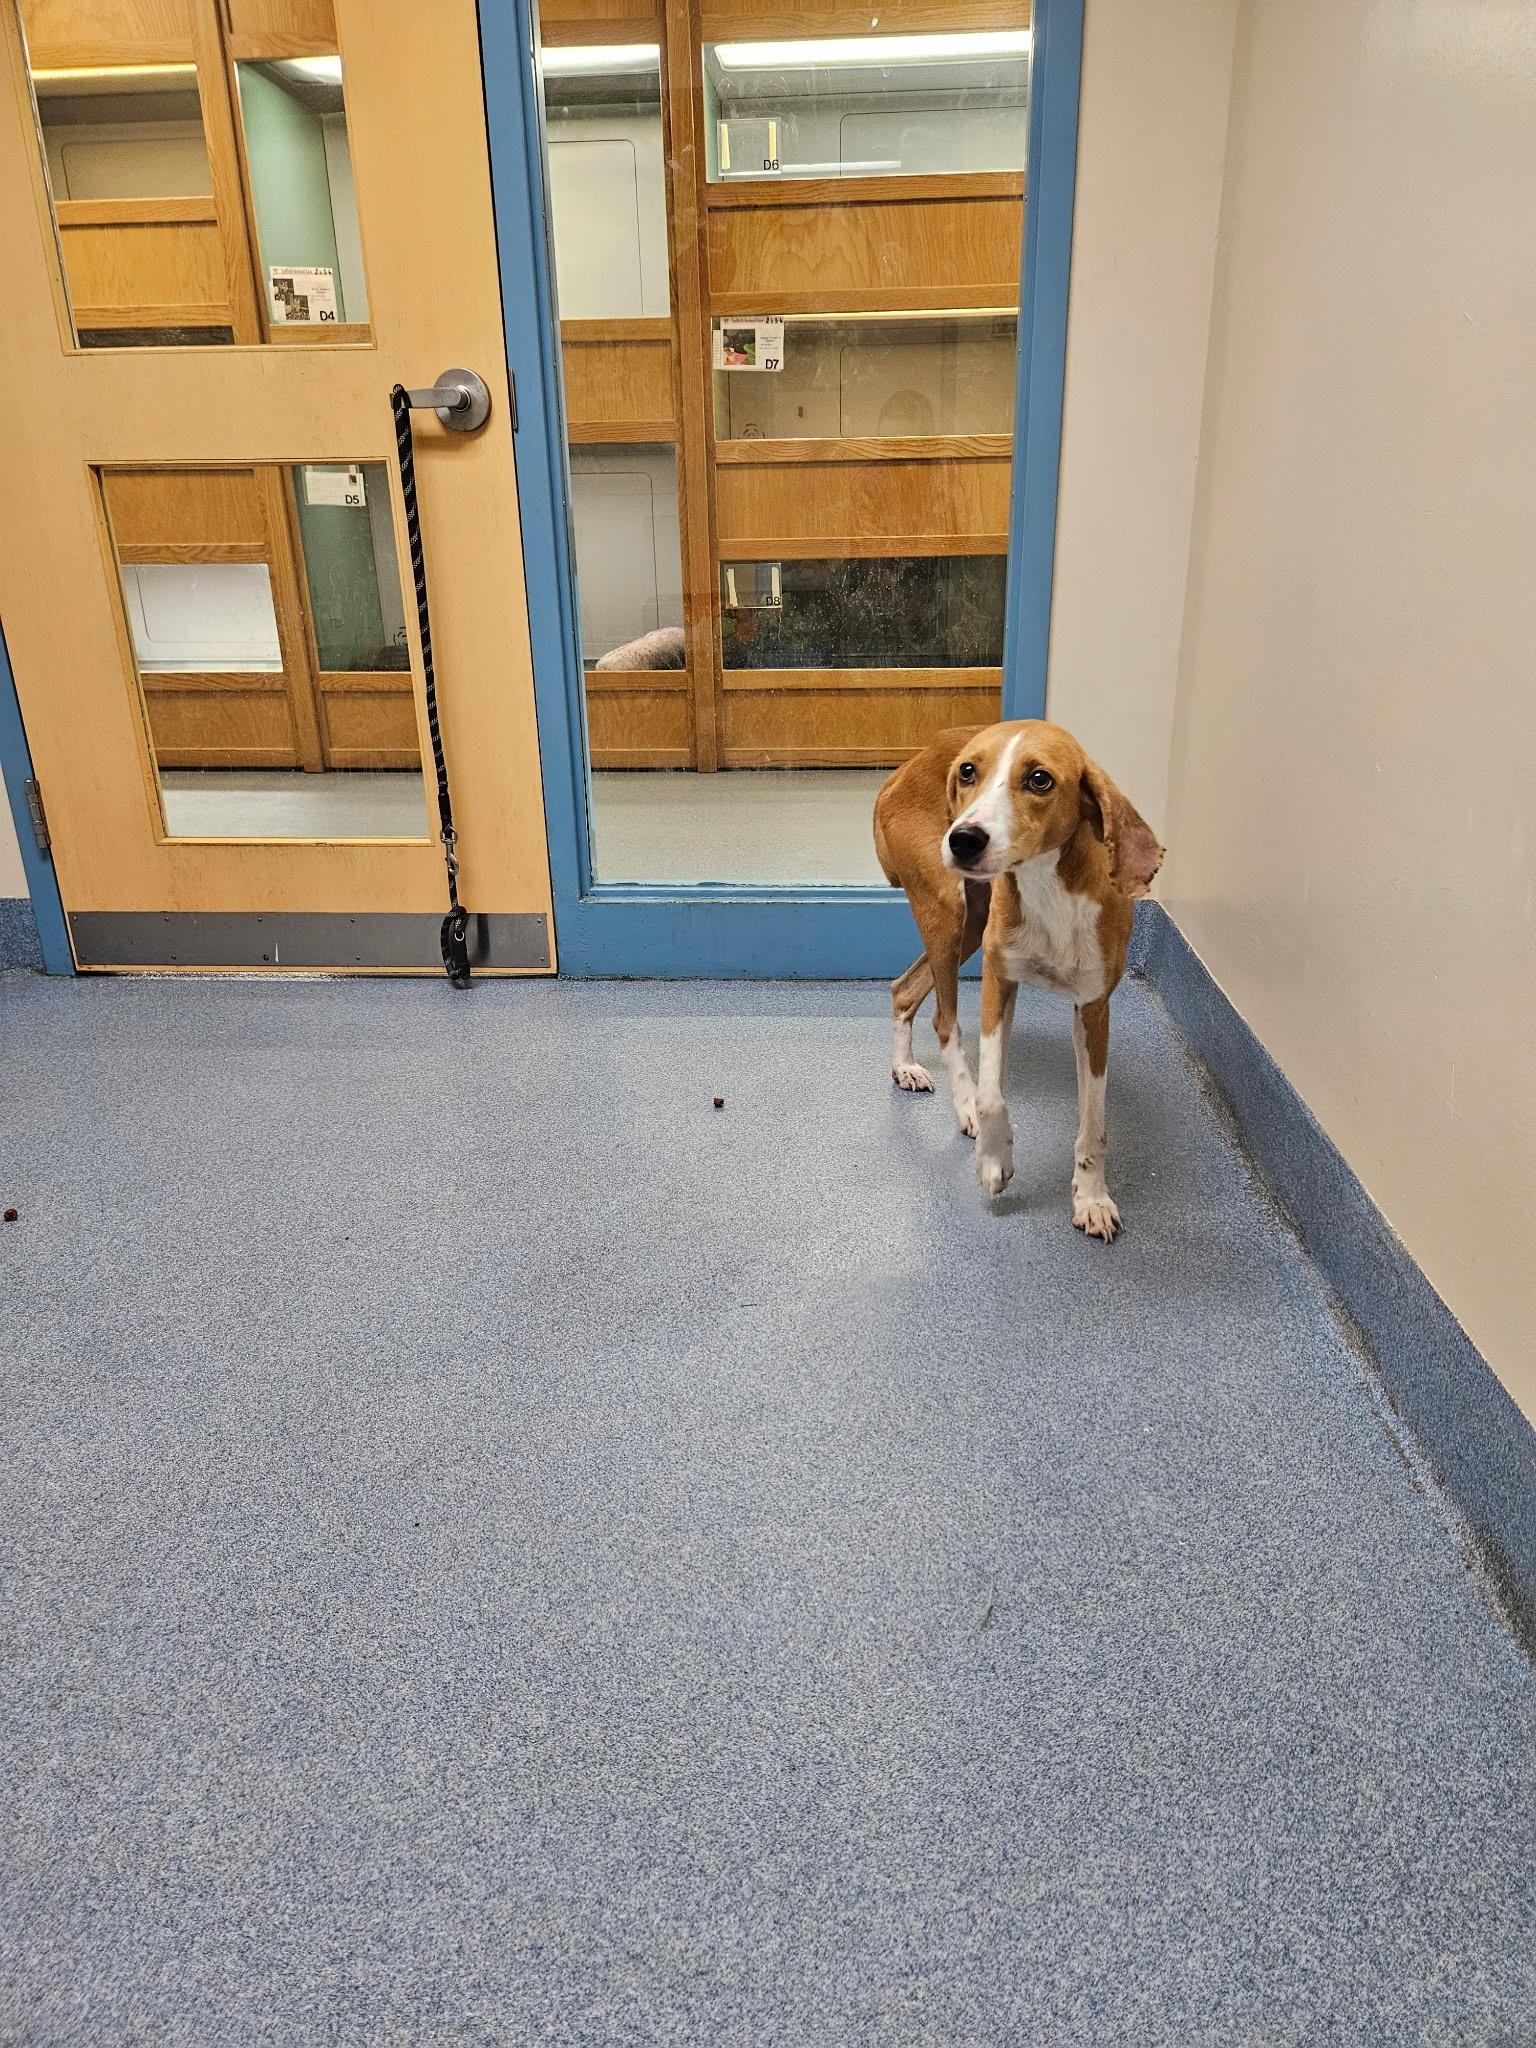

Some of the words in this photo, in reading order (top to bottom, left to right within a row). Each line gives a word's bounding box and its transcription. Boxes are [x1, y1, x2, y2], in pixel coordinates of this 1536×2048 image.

[763, 159, 779, 171] D6
[319, 310, 335, 321] D4
[765, 358, 780, 370] D7
[345, 494, 360, 505] D5
[765, 596, 781, 606] D8
